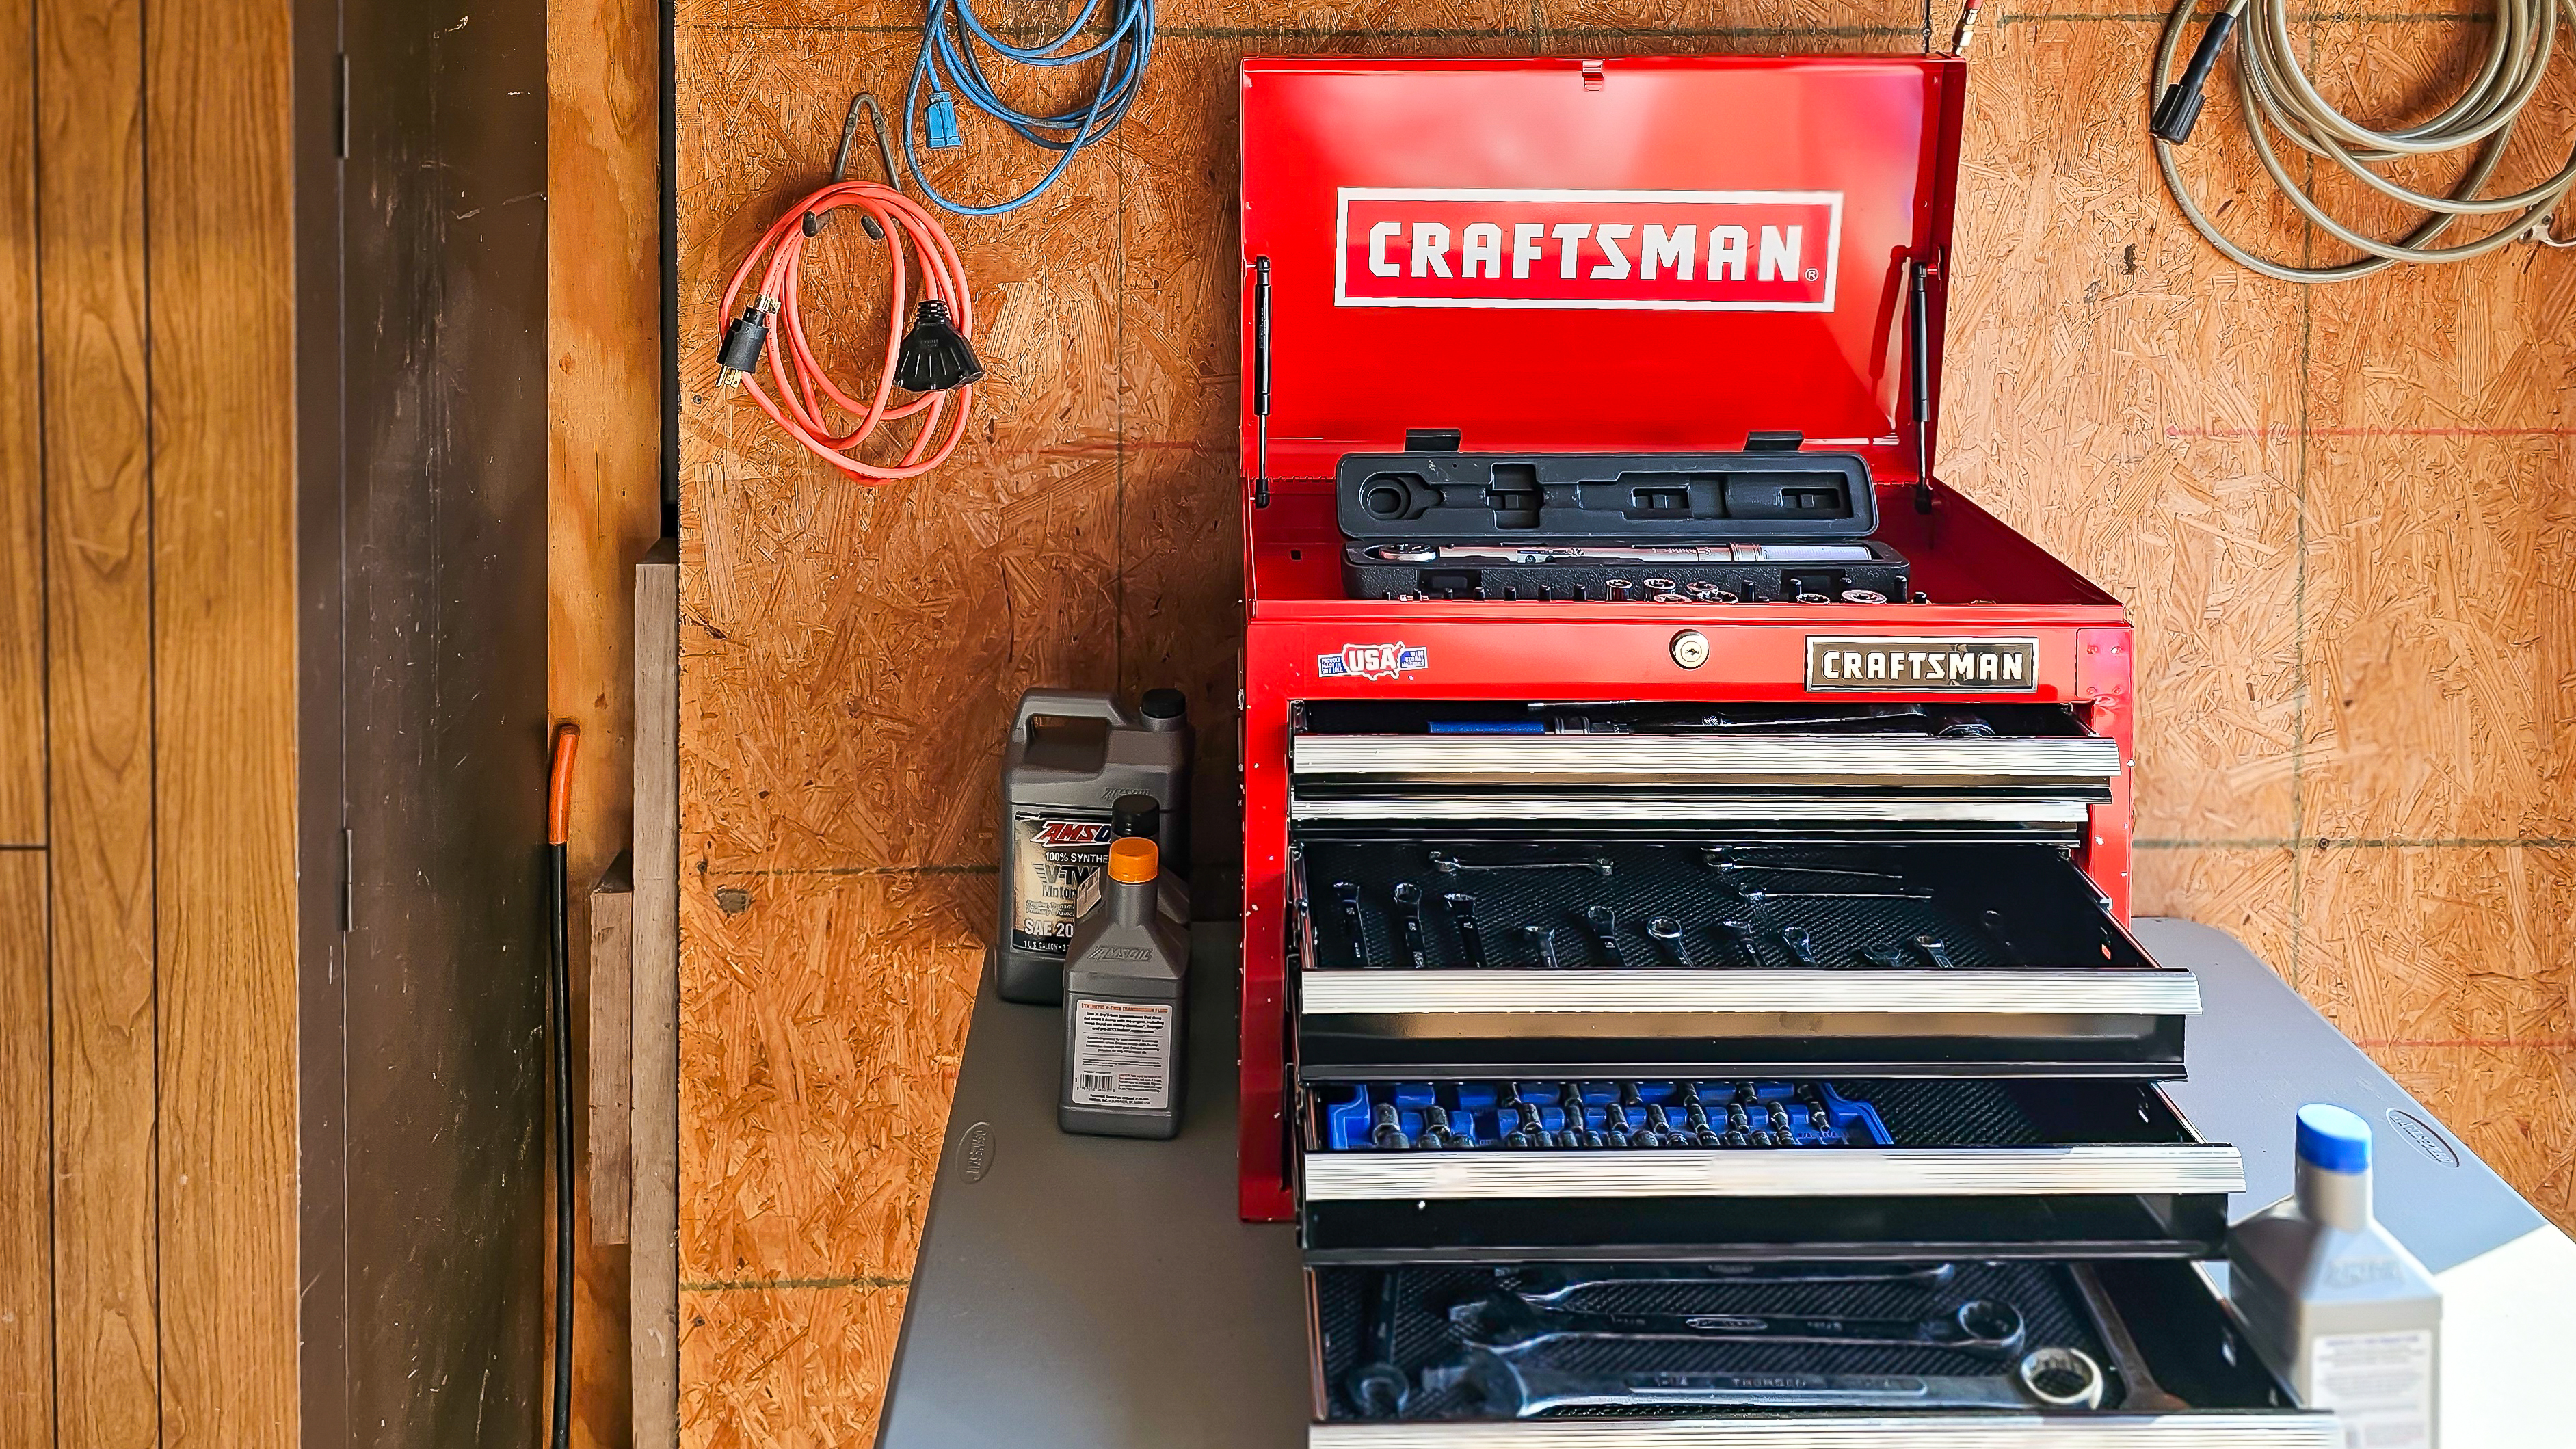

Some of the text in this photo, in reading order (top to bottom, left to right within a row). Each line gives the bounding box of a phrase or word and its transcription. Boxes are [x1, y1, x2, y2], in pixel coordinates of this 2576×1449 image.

[1368, 221, 1803, 282] CRAFTSMAN
[1348, 648, 1398, 672] USA
[1822, 650, 2023, 680] CRAFTSMAN
[1046, 851, 1108, 863] 100% SYNTHE
[1024, 918, 1074, 938] SAE 20
